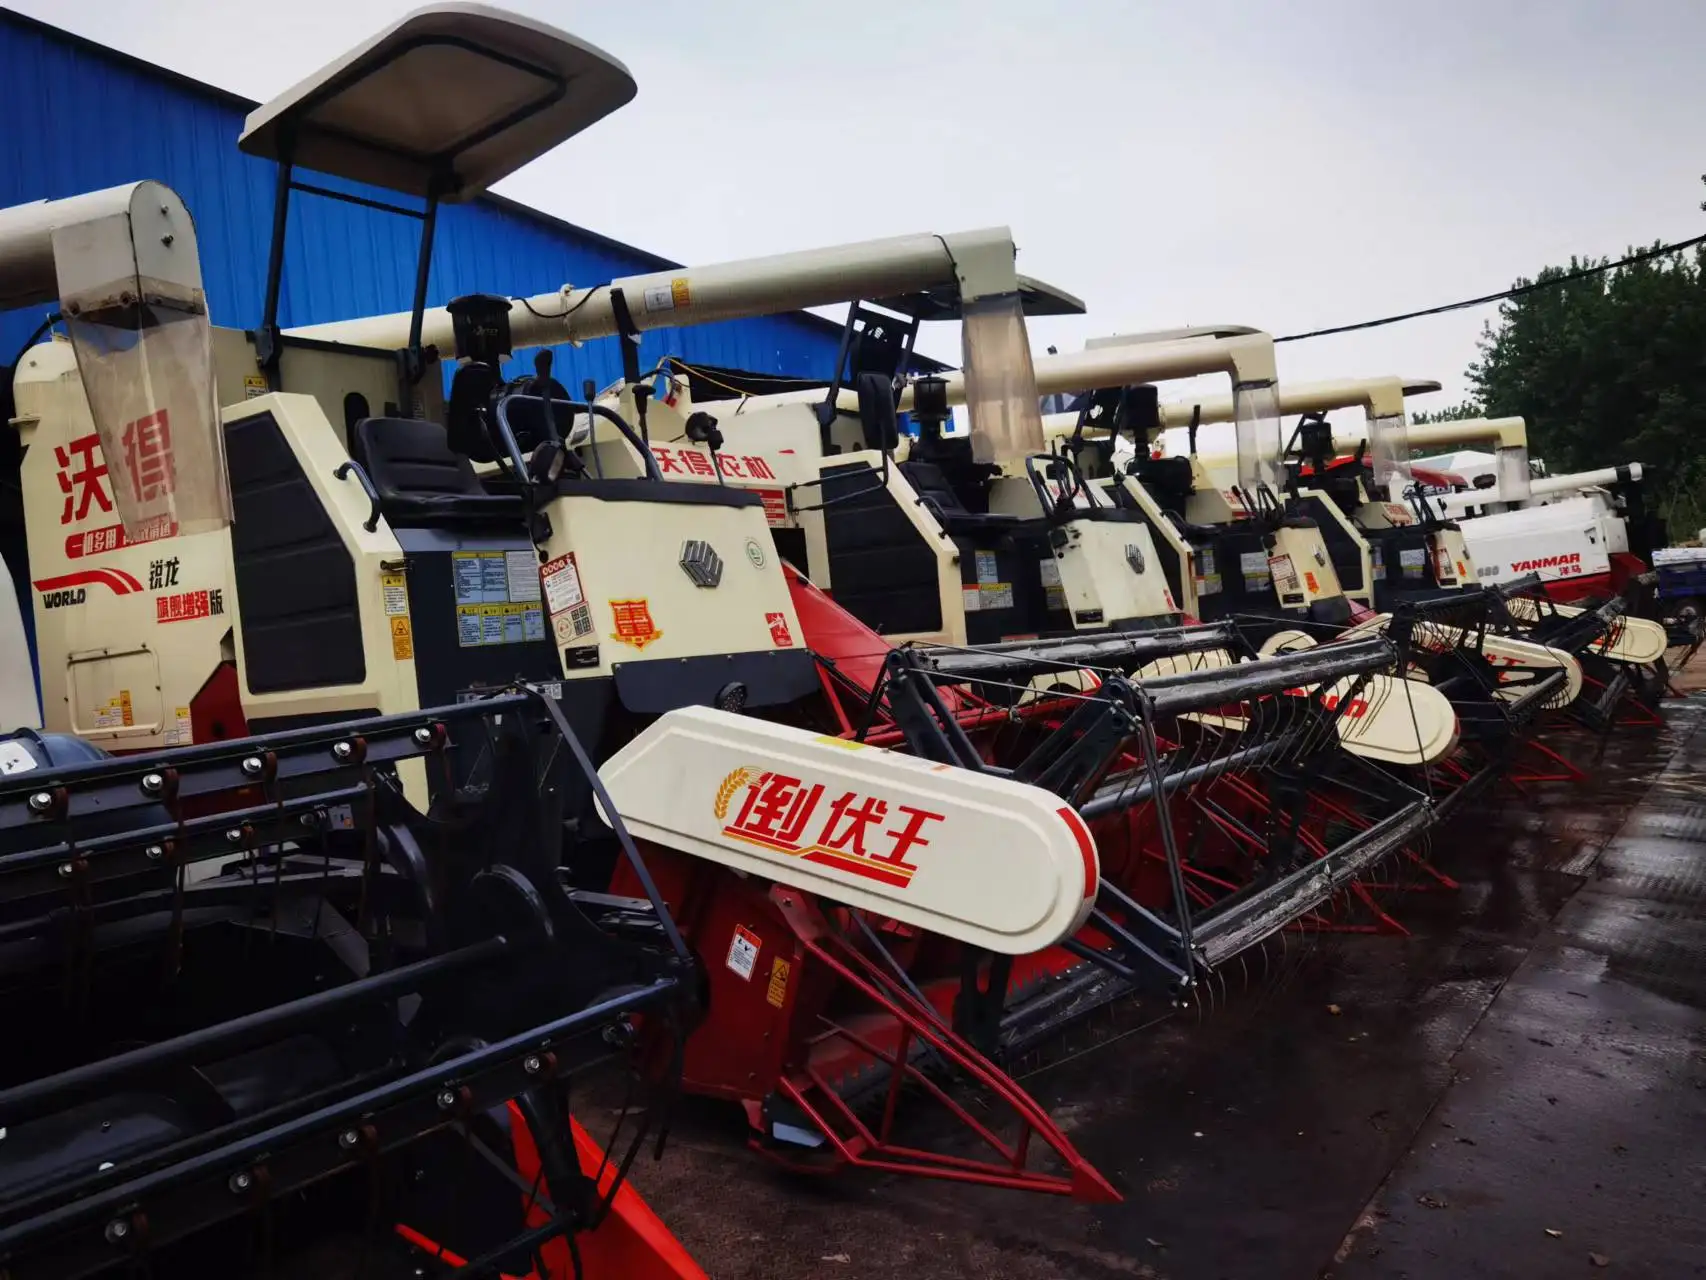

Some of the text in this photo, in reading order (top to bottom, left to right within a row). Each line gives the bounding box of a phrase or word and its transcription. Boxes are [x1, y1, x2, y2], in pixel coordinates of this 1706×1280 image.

[149, 556, 181, 591] 锐龙
[1510, 552, 1581, 573] YANMAR
[1558, 564, 1582, 577] 洋马
[43, 588, 86, 609] WORLD
[156, 588, 225, 621] 旗舰增强版
[734, 771, 946, 872] 倒伏王
